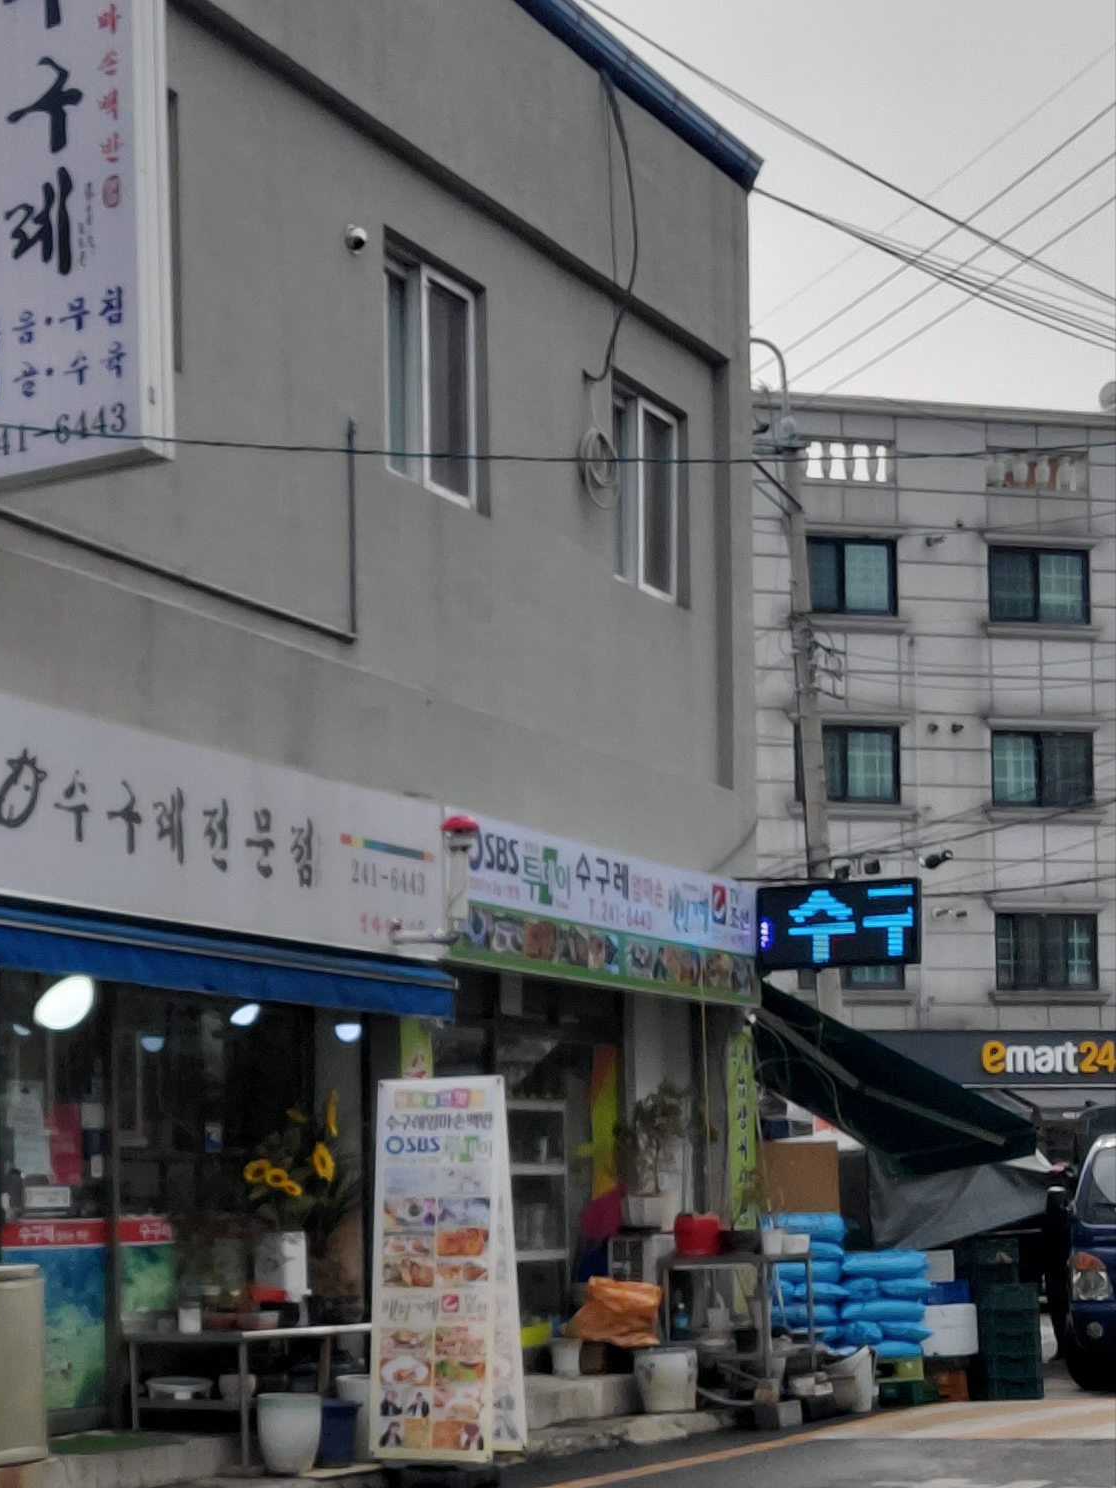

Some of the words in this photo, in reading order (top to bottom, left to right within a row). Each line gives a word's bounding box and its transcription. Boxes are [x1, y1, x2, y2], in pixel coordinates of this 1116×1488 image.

[350, 858, 426, 897] 241-6443
[575, 851, 630, 902] 수구레
[787, 884, 915, 964] 수구
[981, 1040, 1116, 1074] emart24
